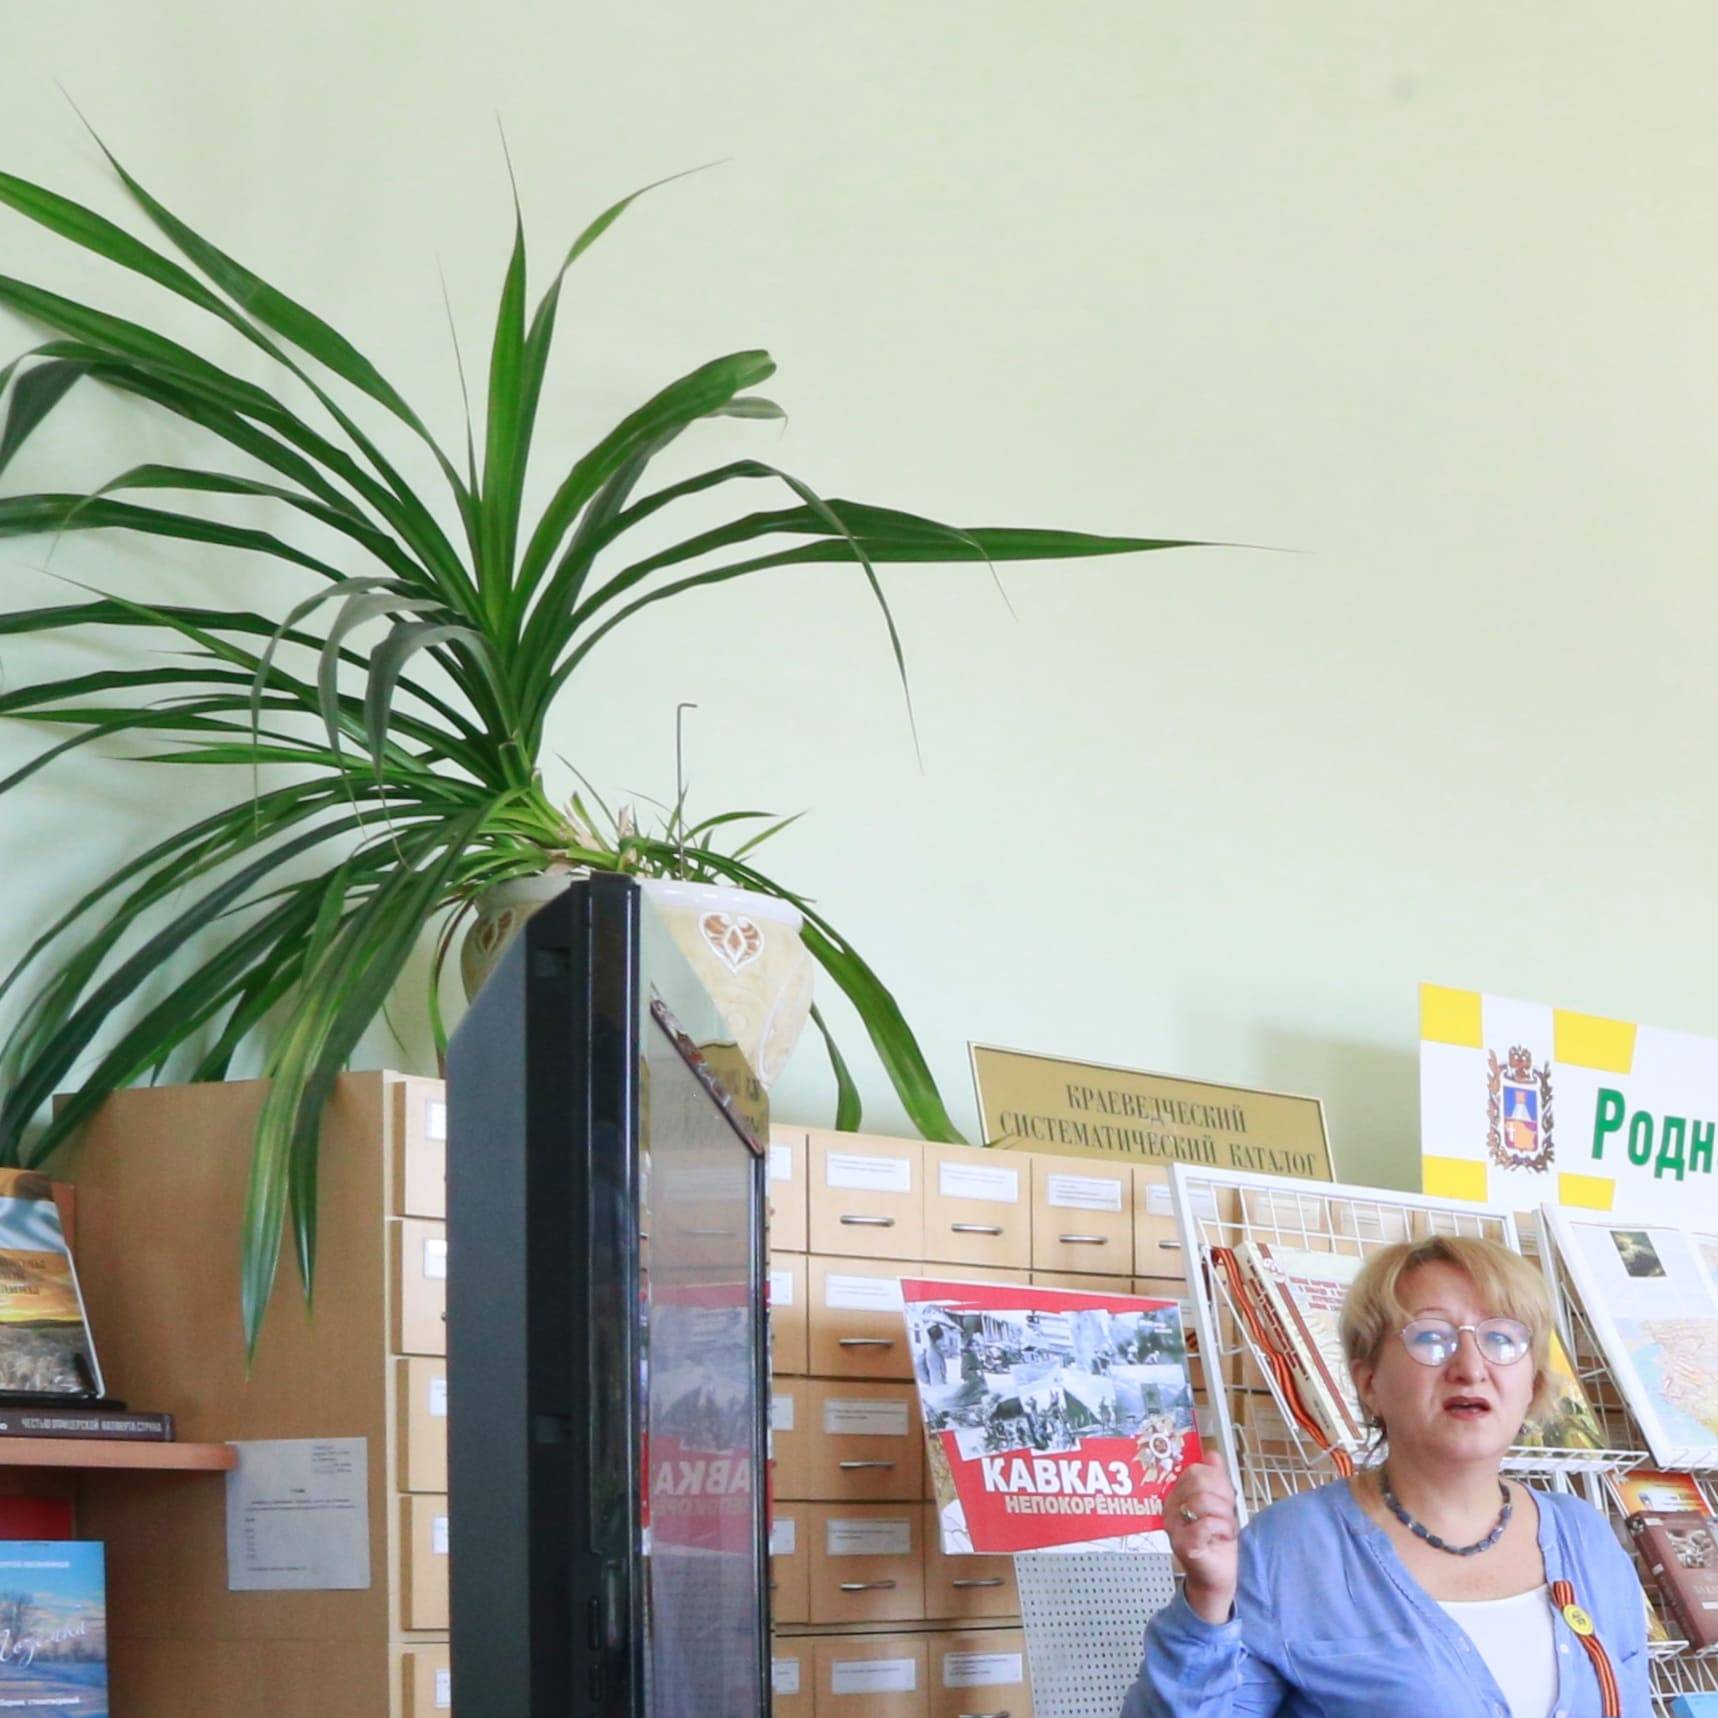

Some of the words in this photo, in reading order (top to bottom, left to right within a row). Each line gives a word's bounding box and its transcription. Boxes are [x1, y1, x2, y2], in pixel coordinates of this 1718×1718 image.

[1065, 1083, 1248, 1134] КРАЕВЕДЧЕСКИЙ
[999, 1110, 1217, 1164] СИСТЕМАТИЧЕСКИЙ
[1229, 1143, 1317, 1177] КАТАЛОГ
[981, 1457, 1133, 1496] КАВКАЗ
[1004, 1494, 1164, 1516] НЕПОКОРЁННЫЙ
